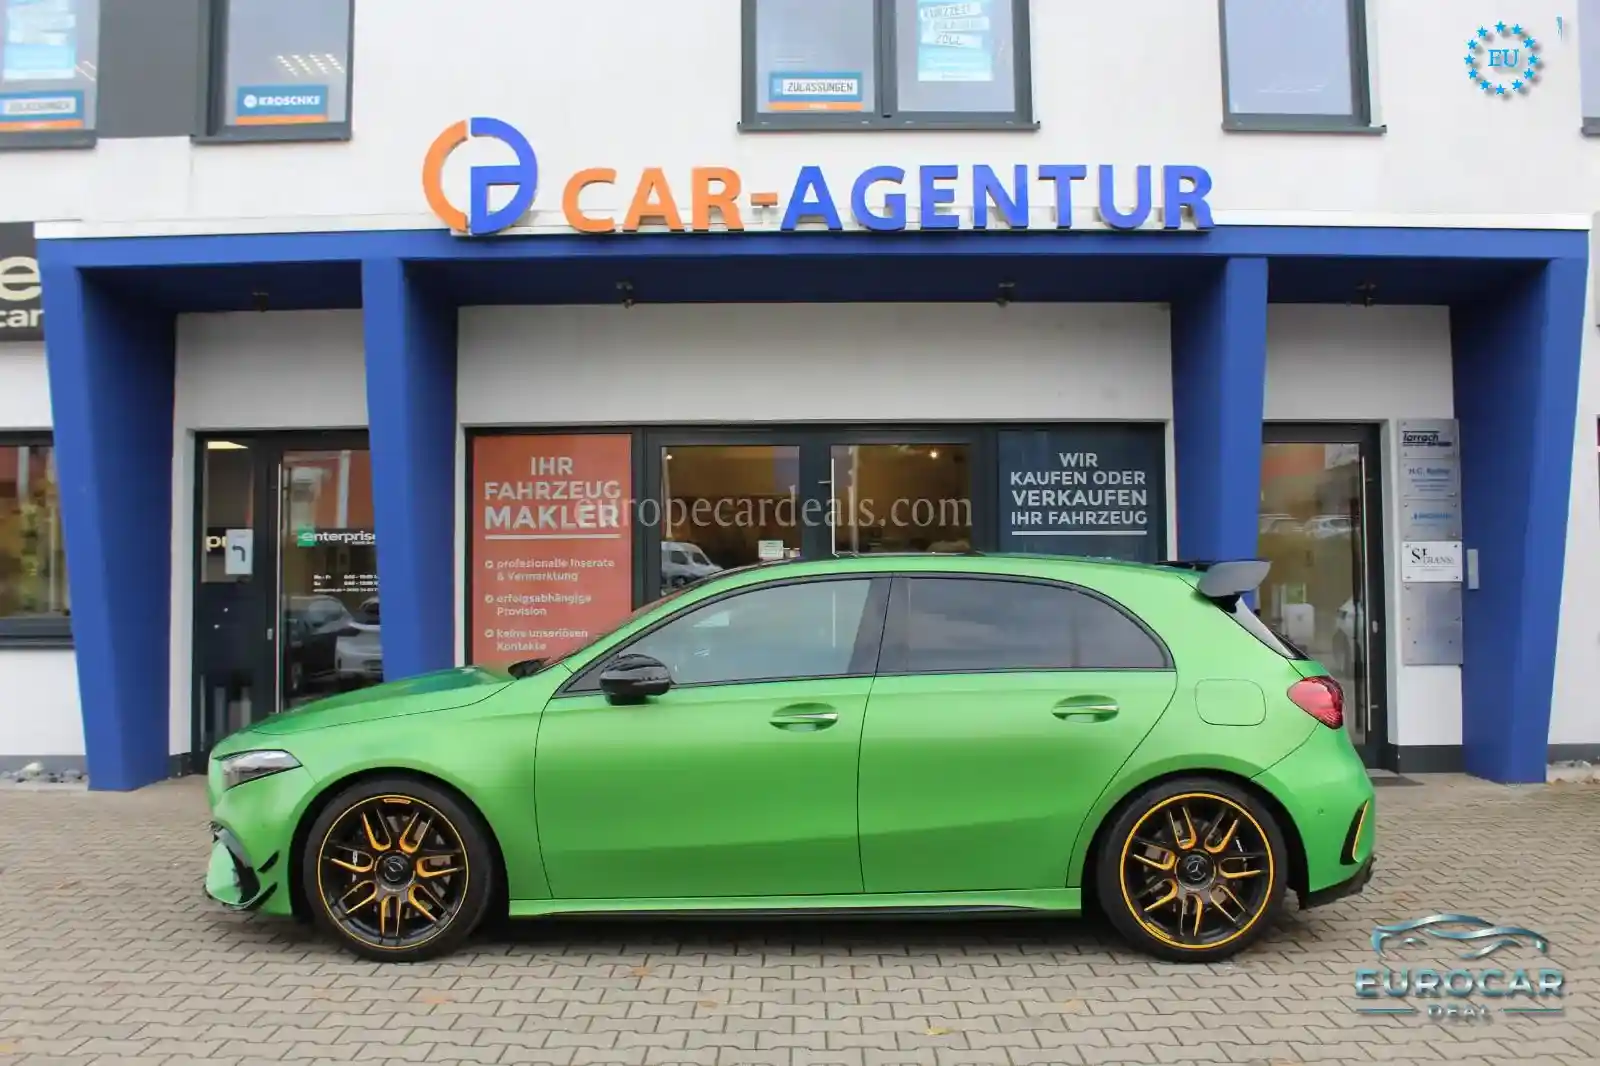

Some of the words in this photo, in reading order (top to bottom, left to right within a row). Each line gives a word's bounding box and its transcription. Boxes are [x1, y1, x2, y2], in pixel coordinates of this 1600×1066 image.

[787, 81, 853, 93] ZULASSUNGEN
[259, 95, 320, 106] KROSCHKE
[562, 164, 1214, 232] CAR-AGENTUR
[530, 456, 574, 476] IHR
[1059, 452, 1098, 468] WIR
[1010, 471, 1087, 486] KAUFEN
[1092, 470, 1146, 486] ODER
[484, 480, 622, 501] FAHRZEUG
[1011, 489, 1148, 507] VERKAUFEN
[484, 504, 620, 531] MAKLER
[1011, 511, 1043, 526] IHR
[1048, 510, 1148, 526] FAHRZEUG
[301, 530, 376, 544] enterpris
[570, 557, 616, 568] Inserate
[508, 571, 579, 583] Vermarktung
[496, 593, 593, 605] erfolgsabhängige
[496, 606, 548, 617] Provision
[496, 628, 527, 638] keine
[529, 627, 589, 639] unseriösen
[496, 641, 547, 651] Kontakte
